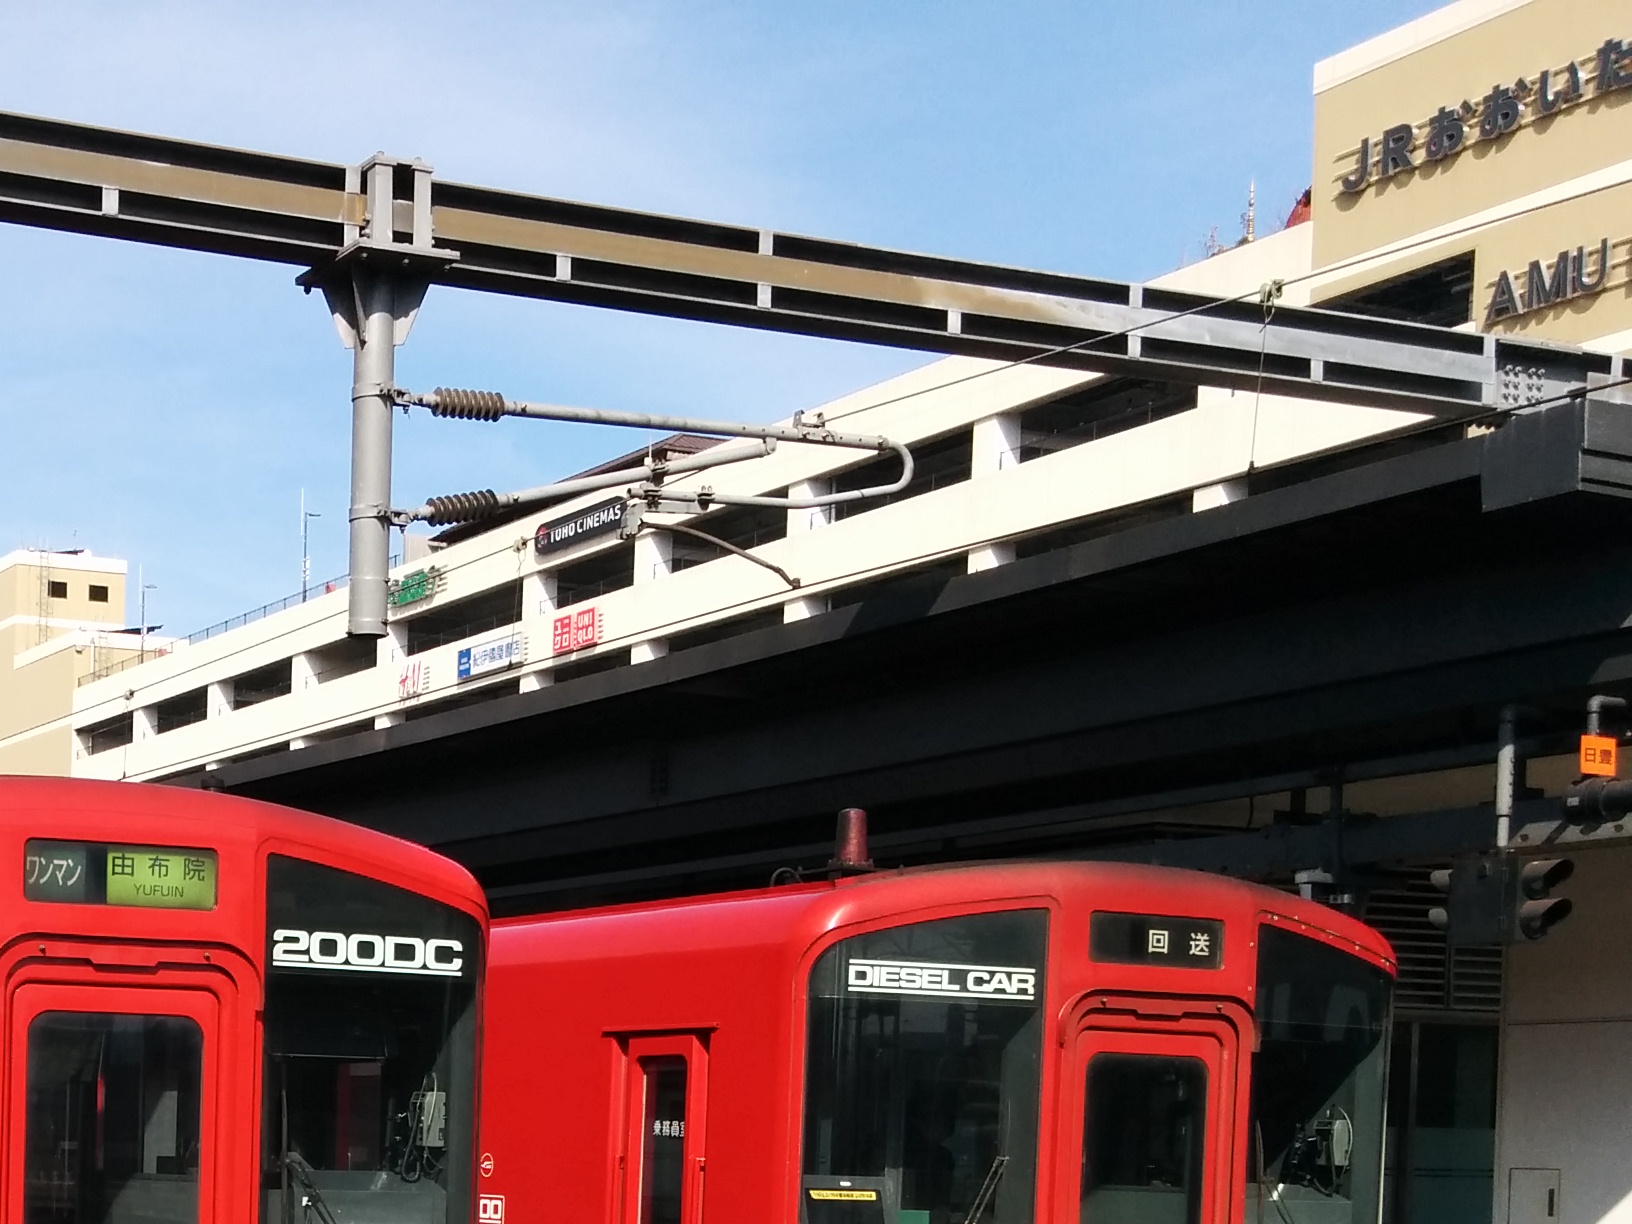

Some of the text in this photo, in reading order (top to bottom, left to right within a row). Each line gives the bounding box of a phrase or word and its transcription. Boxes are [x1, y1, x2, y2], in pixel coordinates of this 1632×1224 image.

[1486, 237, 1610, 325] AMU
[550, 504, 622, 544] TOHO CINEMAS
[577, 611, 593, 628] UNI
[577, 625, 593, 644] QLO
[25, 856, 82, 887] ワンマン
[111, 852, 206, 882] 由布院
[133, 883, 185, 898] YUFUIN
[272, 928, 464, 971] 200DC
[1148, 929, 1210, 956] 回送
[847, 964, 1036, 995] DIESEL CAR
